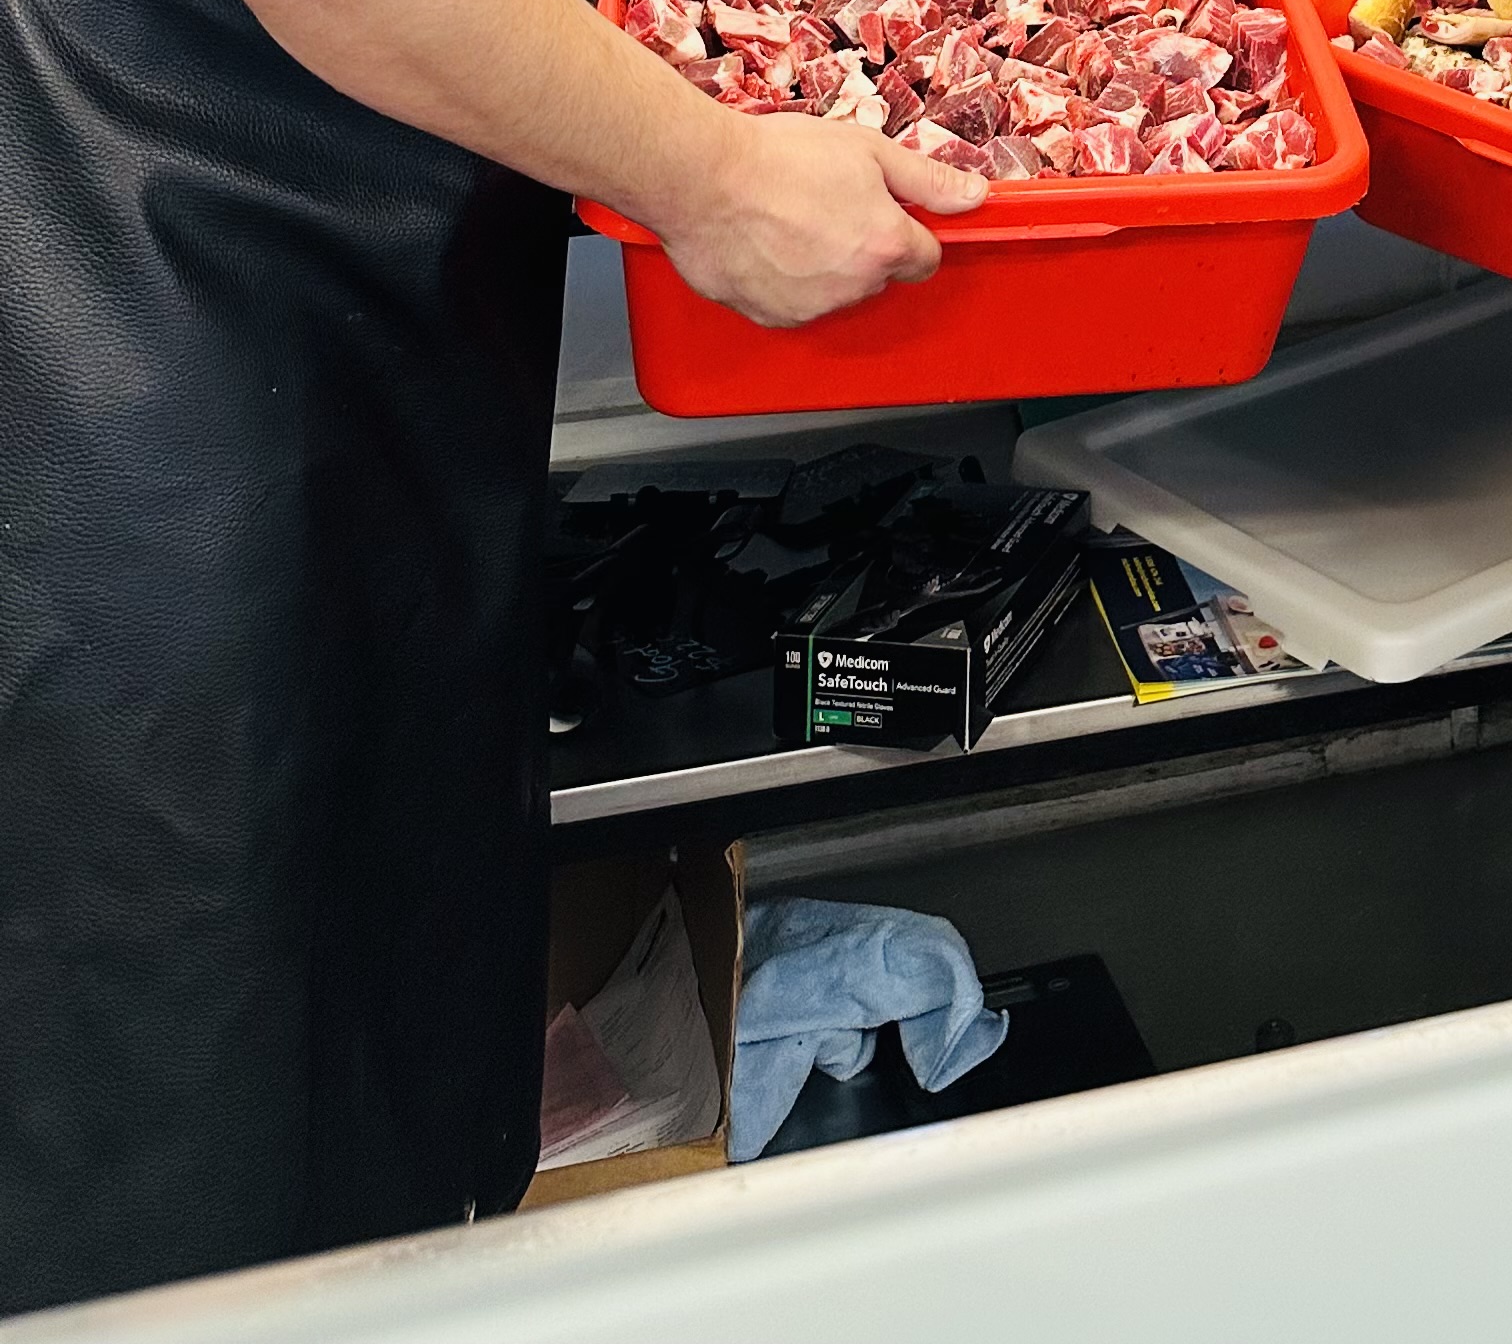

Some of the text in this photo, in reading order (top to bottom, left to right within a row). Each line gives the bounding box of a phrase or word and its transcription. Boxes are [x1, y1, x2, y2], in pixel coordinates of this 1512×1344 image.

[835, 653, 889, 672] Medicom
[817, 673, 888, 693] SafeTouch
[896, 681, 932, 694] Advanced
[856, 715, 880, 725] BLACK
